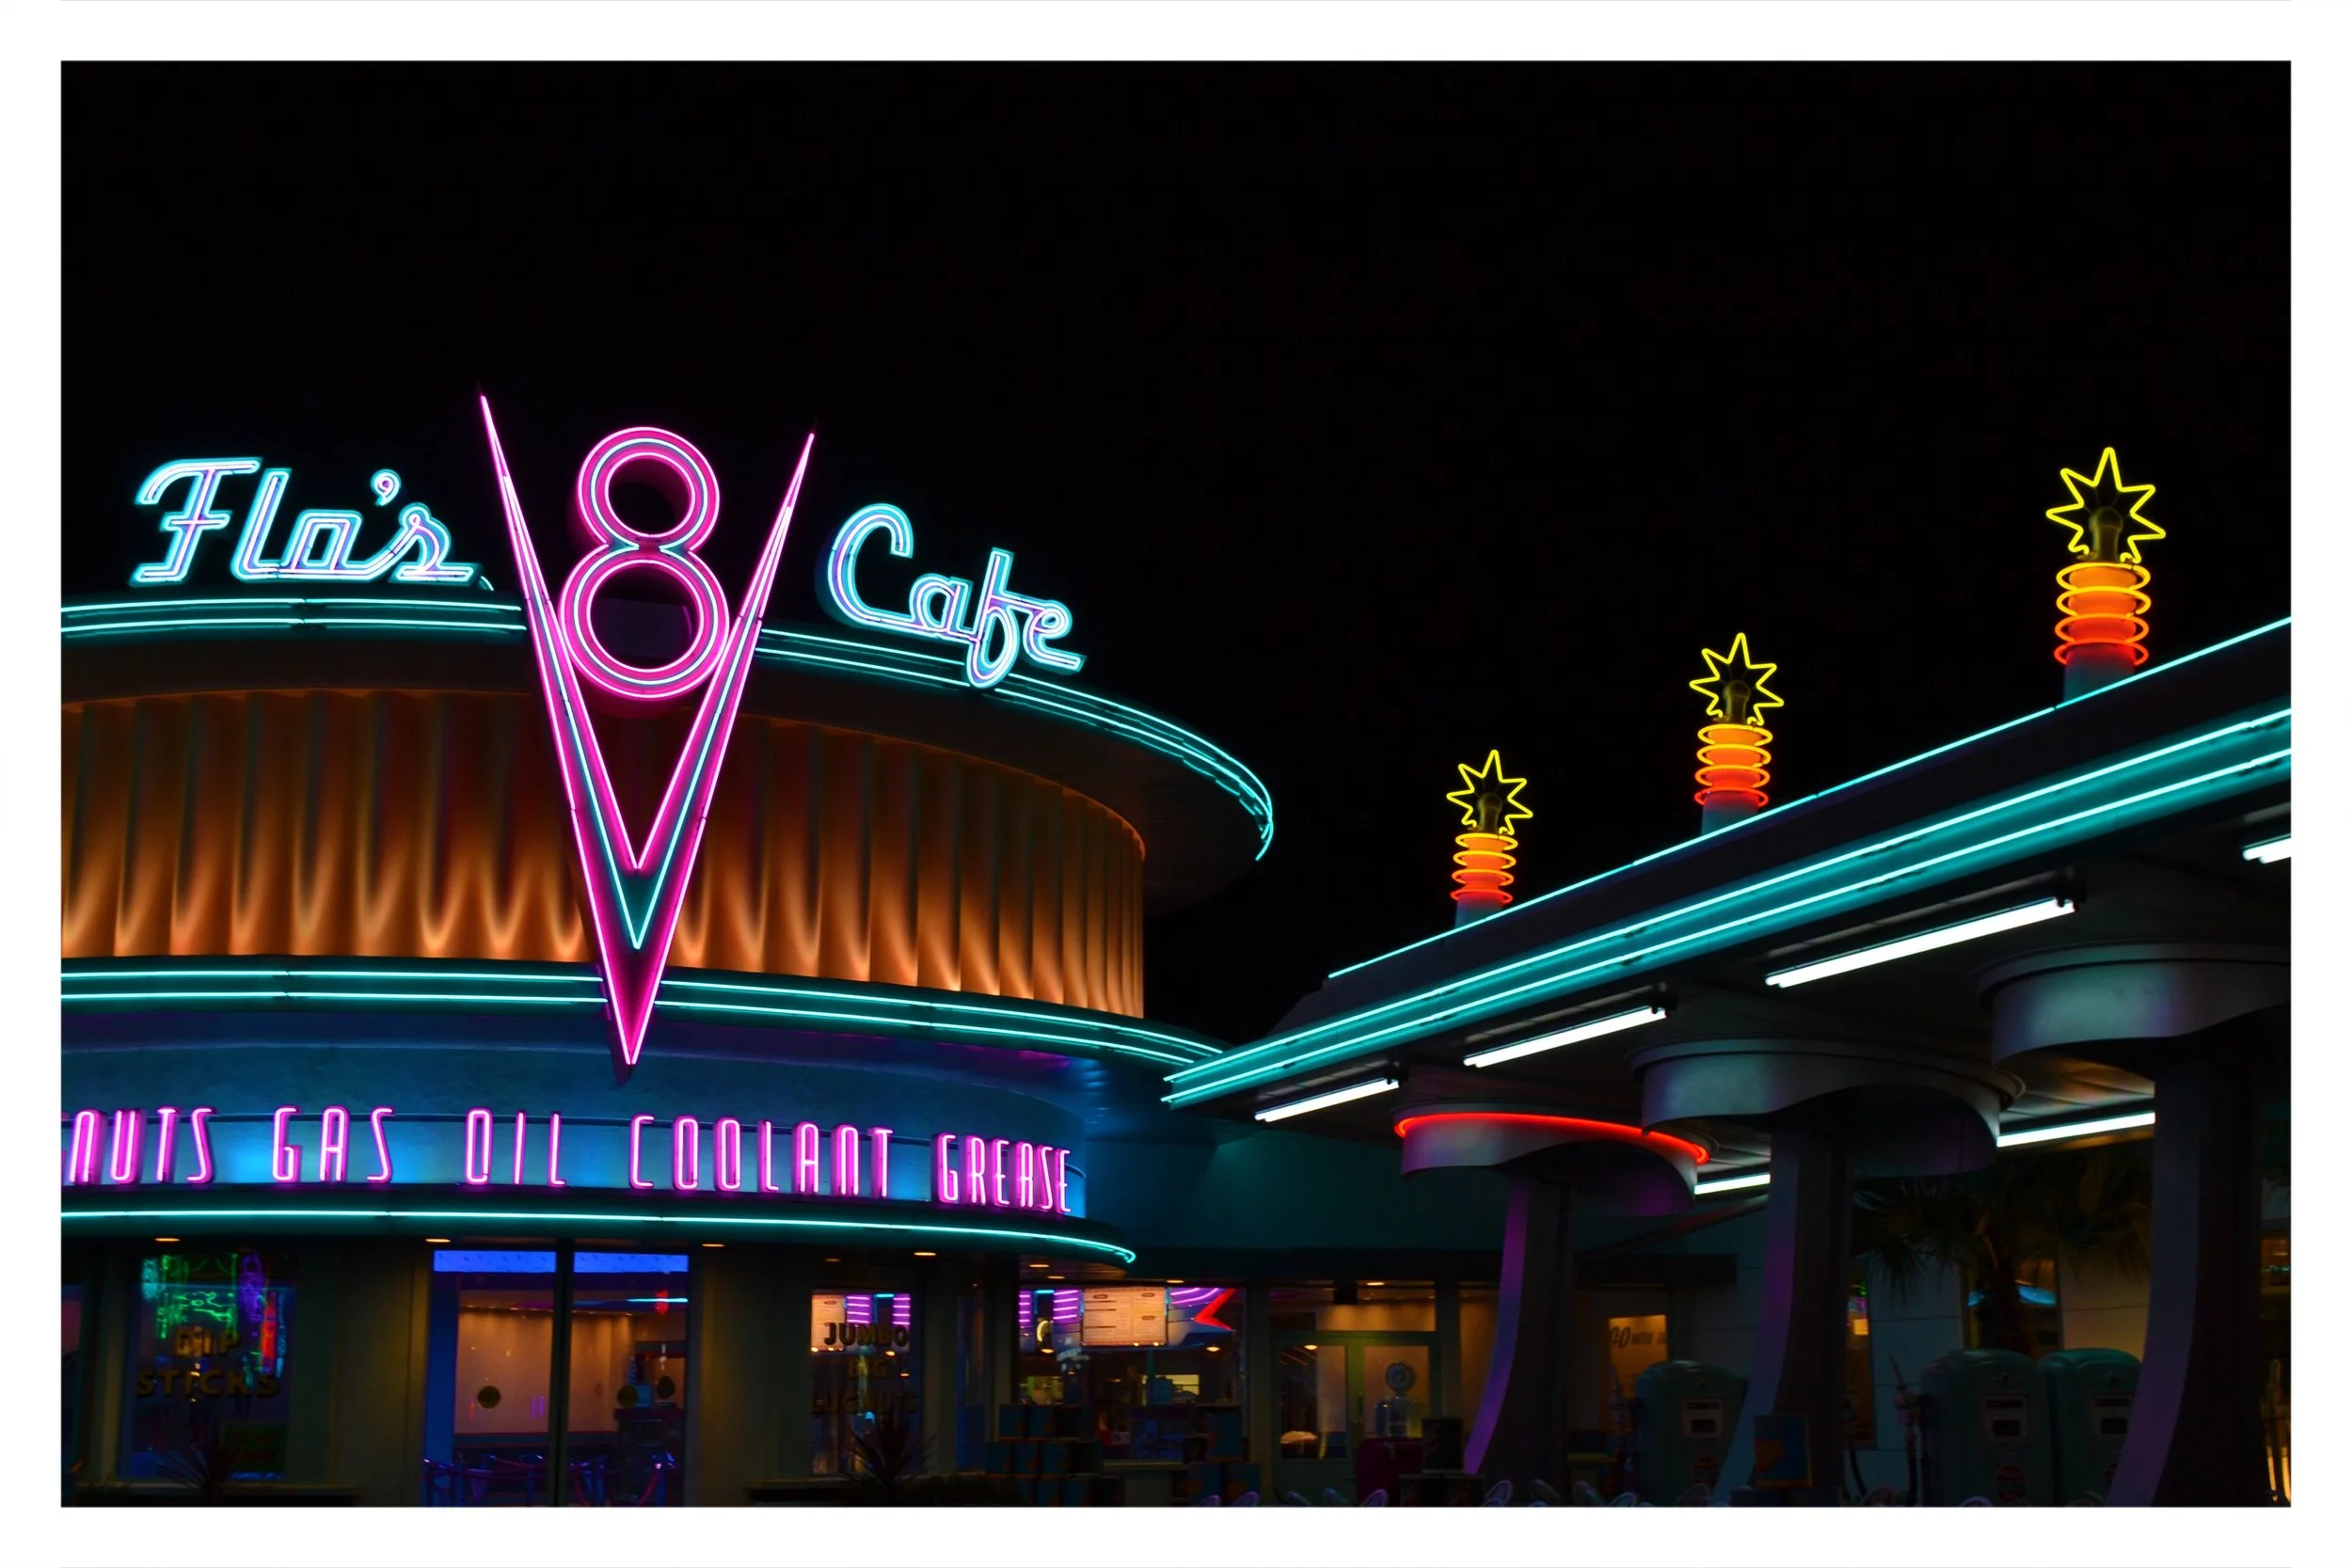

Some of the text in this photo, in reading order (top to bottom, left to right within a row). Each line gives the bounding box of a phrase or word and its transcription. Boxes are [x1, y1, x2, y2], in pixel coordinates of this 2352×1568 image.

[129, 456, 482, 587] Flo's
[826, 502, 1084, 689] Cafe
[271, 1105, 395, 1184] GAS
[463, 1108, 566, 1187] OIL
[628, 1114, 894, 1199] COOLANT
[932, 1133, 1072, 1214] GREASE
[824, 1323, 909, 1347] JUMBO
[136, 1370, 278, 1397] STICKS
